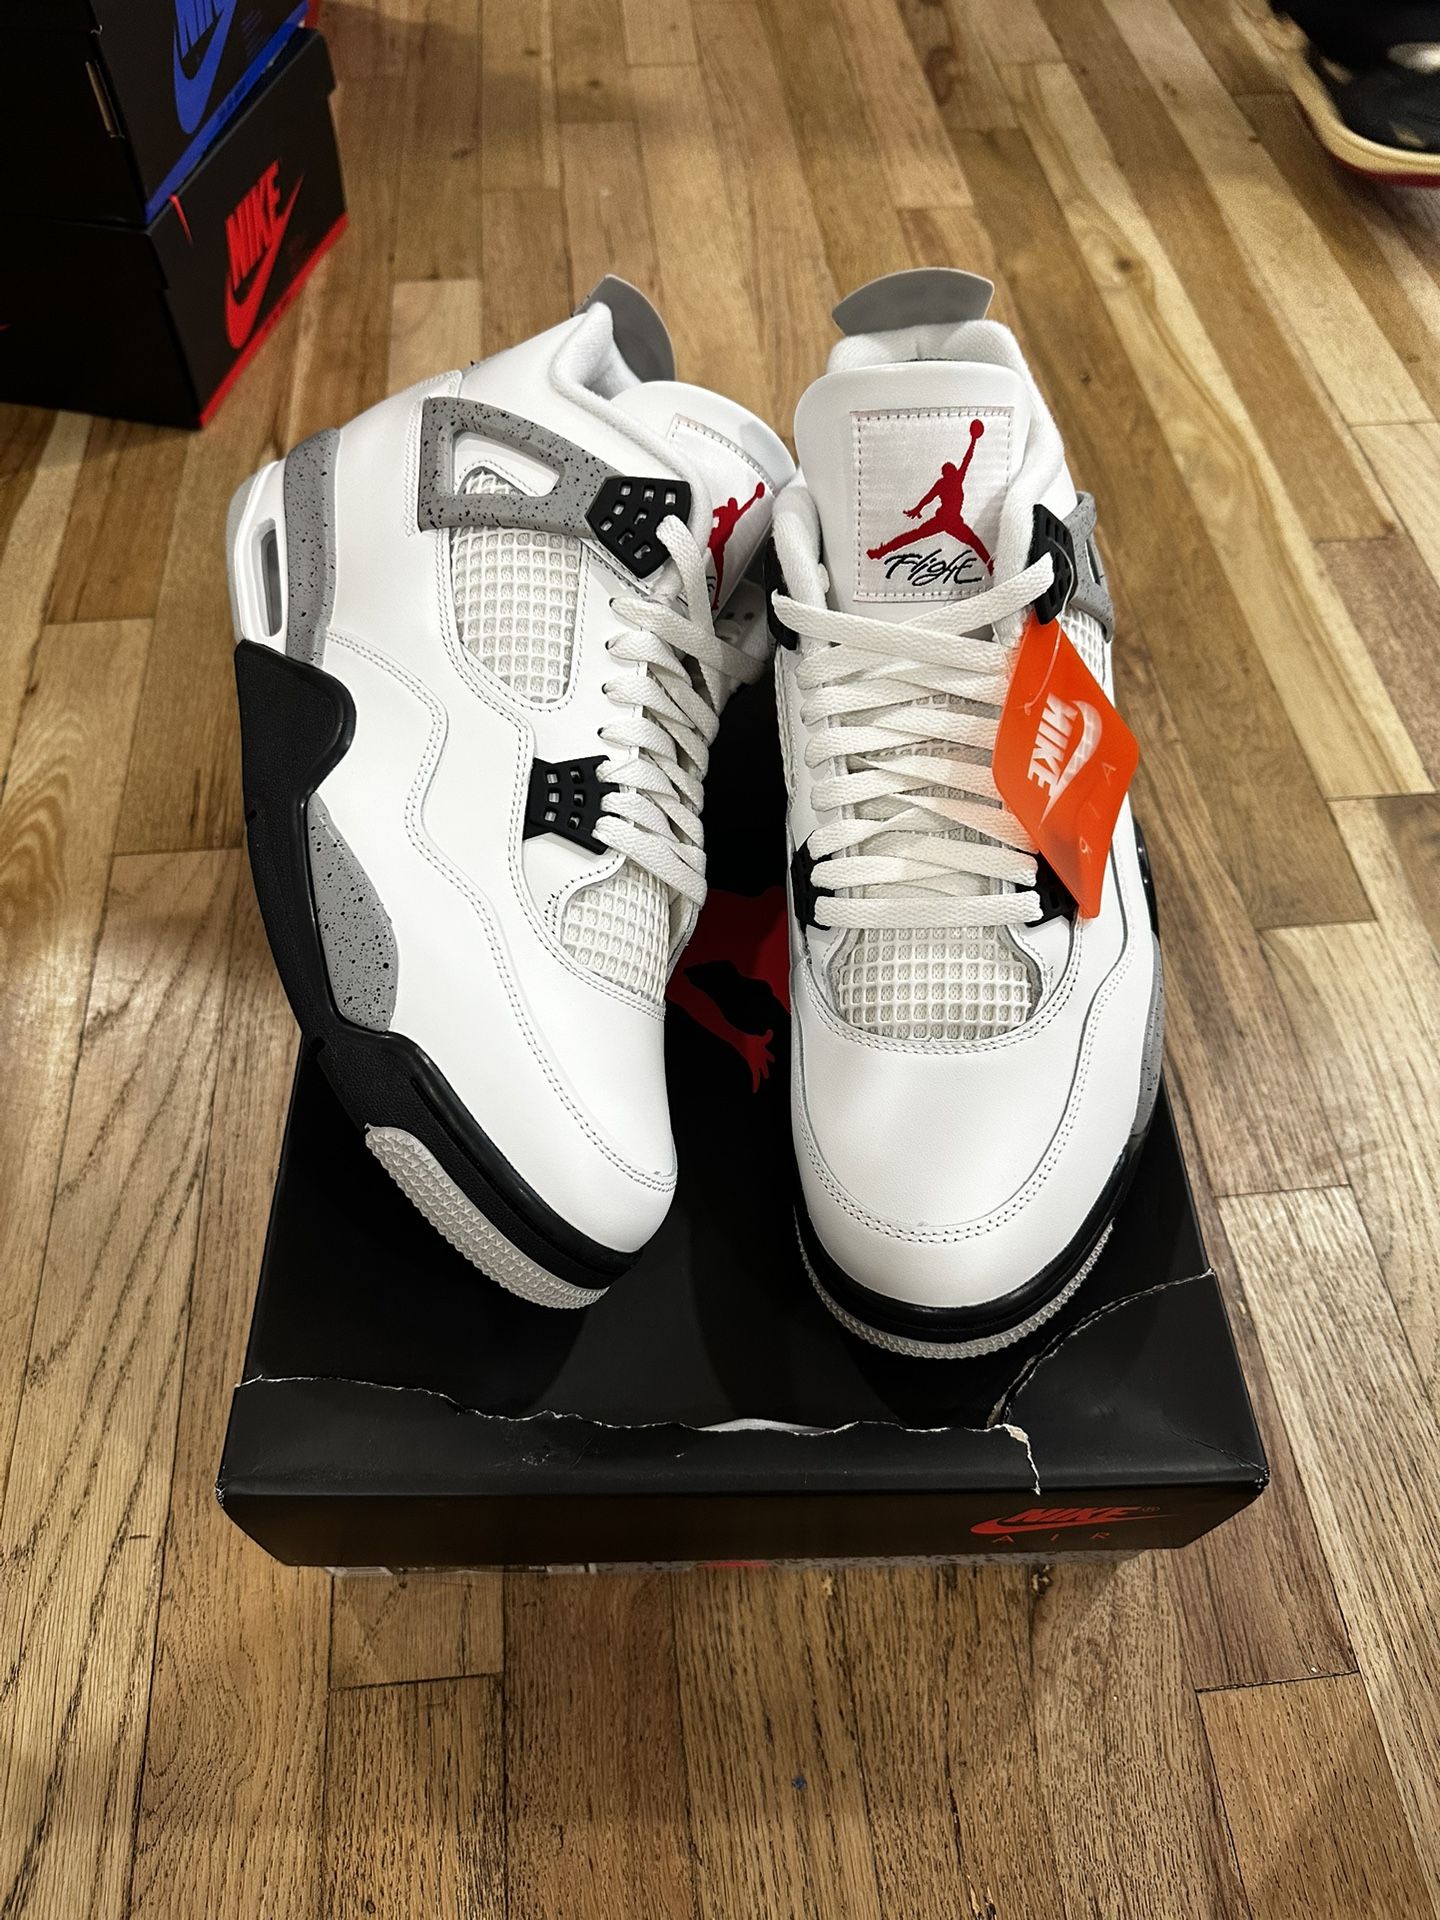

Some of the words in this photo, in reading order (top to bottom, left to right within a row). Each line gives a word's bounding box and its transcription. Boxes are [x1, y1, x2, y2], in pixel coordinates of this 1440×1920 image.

[226, 159, 281, 290] NIKE
[883, 549, 983, 586] Flight
[1004, 1506, 1142, 1523] NIKE
